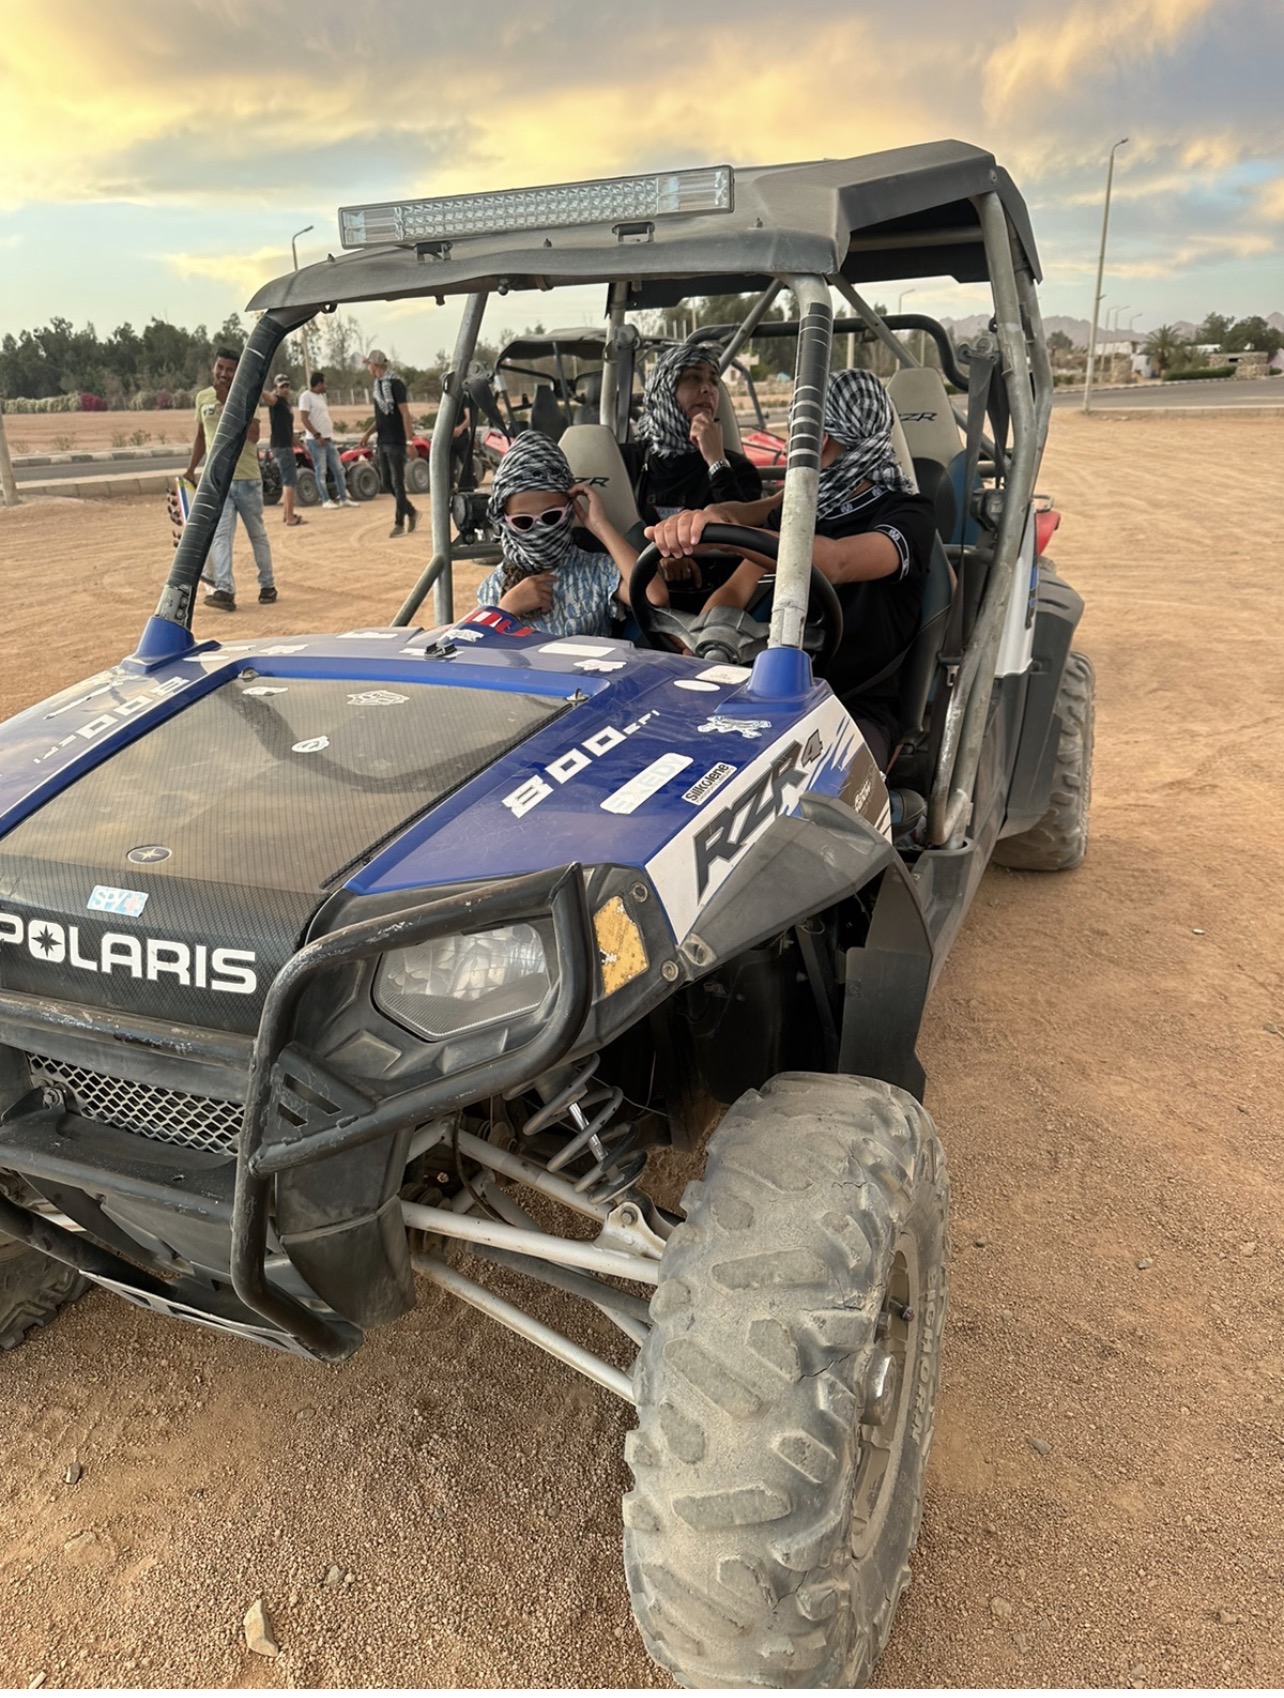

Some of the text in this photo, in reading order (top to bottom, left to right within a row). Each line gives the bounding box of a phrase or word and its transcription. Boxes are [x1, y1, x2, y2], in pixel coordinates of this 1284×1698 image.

[898, 411, 938, 422] ZR
[685, 763, 730, 801] Silkolene
[693, 739, 808, 906] RZR
[0, 912, 257, 994] POLARIS
[911, 1264, 939, 1445] BIGHORN
